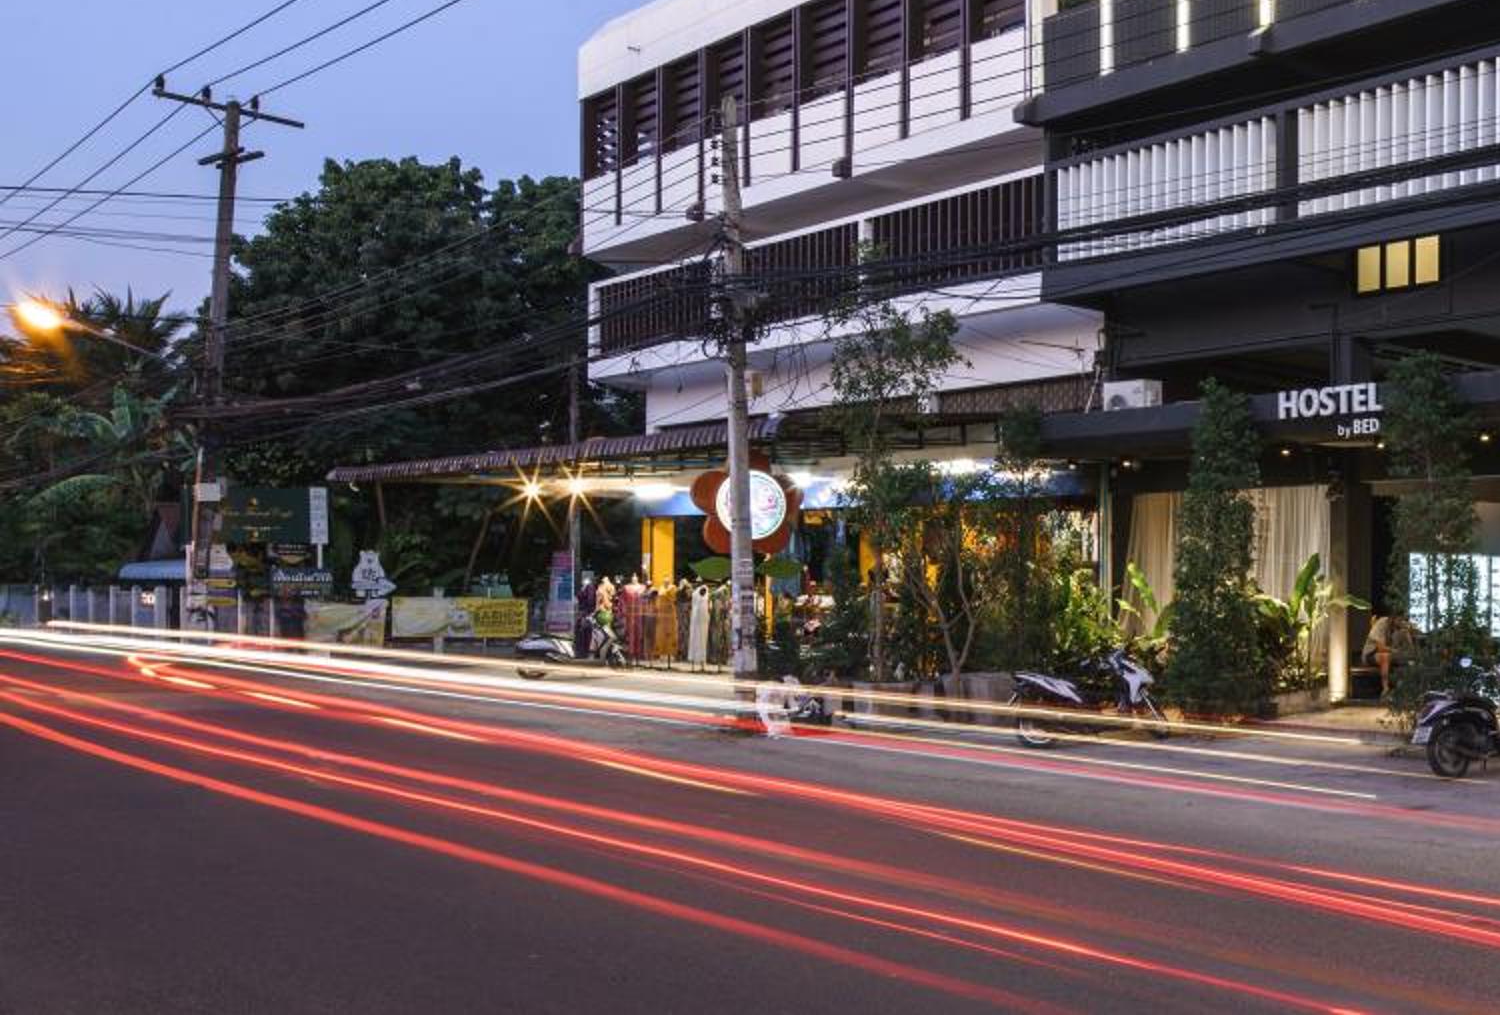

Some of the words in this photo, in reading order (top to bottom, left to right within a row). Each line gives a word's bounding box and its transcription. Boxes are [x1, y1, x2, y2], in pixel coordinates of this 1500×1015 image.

[1278, 382, 1383, 419] HOSTEL
[1337, 425, 1351, 438] by
[1353, 418, 1379, 434] BED
